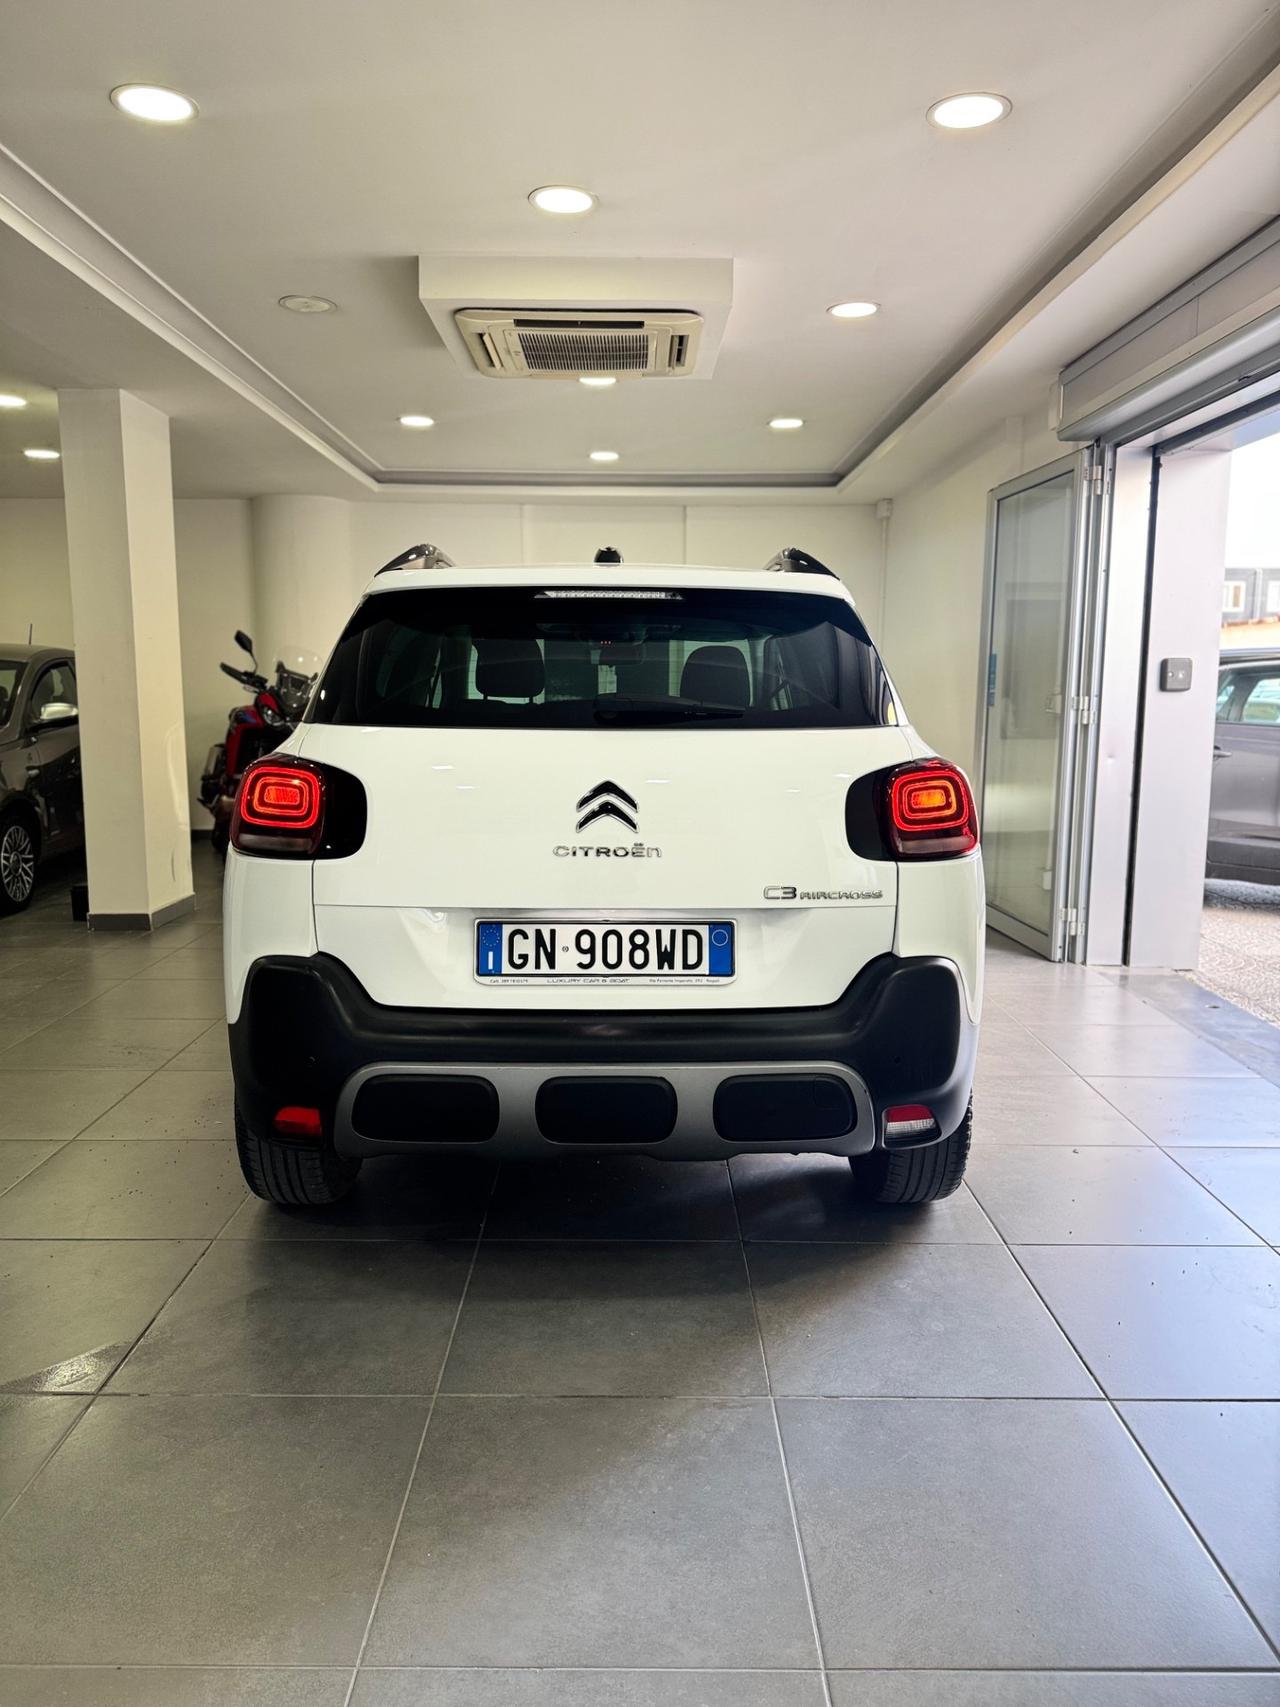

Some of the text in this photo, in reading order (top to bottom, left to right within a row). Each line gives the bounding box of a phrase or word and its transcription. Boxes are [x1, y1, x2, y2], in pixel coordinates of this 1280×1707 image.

[763, 886, 884, 900] C3 AIRCROSS
[508, 929, 556, 970] GN
[575, 929, 704, 970] 908WD
